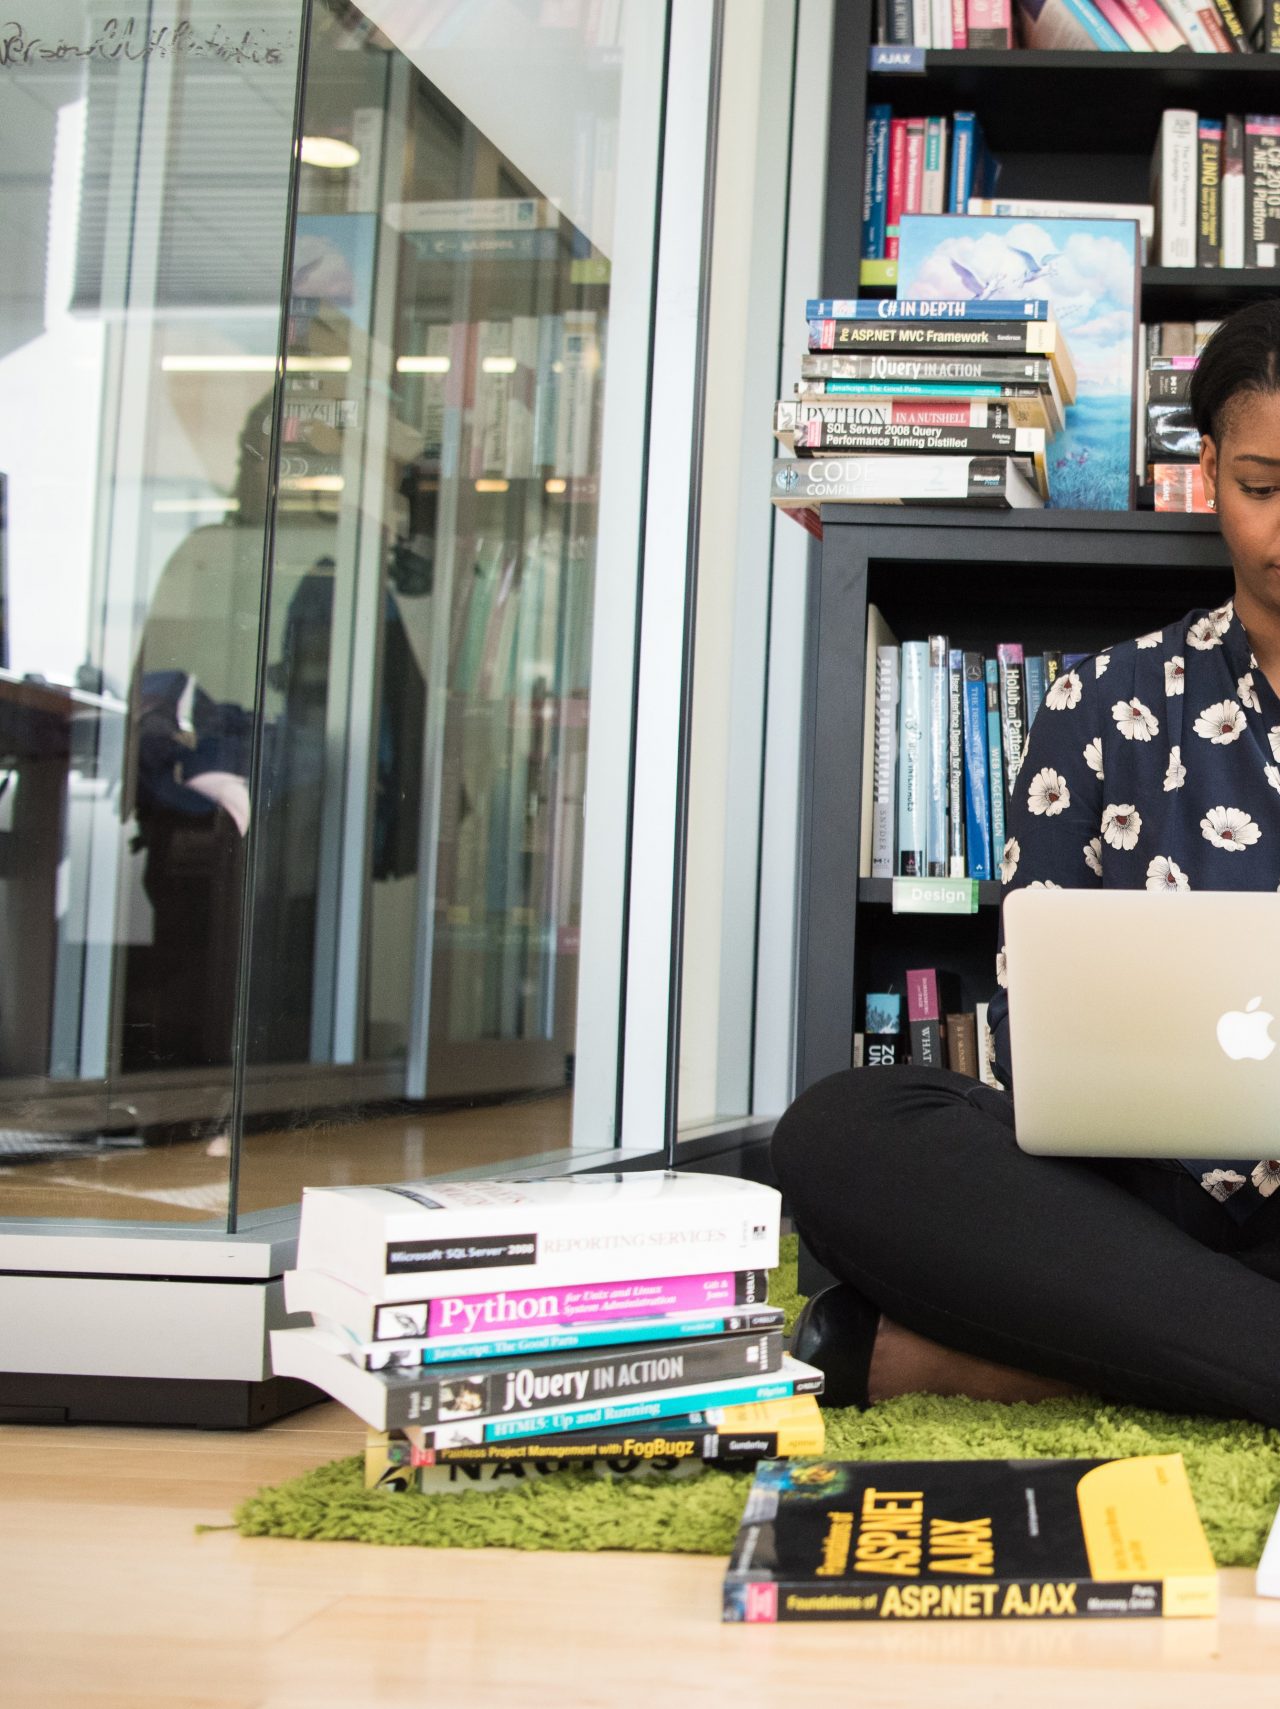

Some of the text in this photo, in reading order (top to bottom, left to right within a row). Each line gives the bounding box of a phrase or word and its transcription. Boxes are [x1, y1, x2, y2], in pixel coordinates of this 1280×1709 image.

[879, 53, 911, 64] AJAX
[1201, 153, 1217, 185] LINQ
[864, 149, 876, 221] Communications
[1252, 147, 1267, 241] .NET 4 Platform
[878, 300, 966, 318] C# IN DEPTH
[840, 327, 848, 342] Pro
[851, 329, 896, 342] ASP.NET
[899, 330, 924, 342] MVC
[926, 331, 989, 343] Framework
[869, 358, 981, 378] jQuery IN ACTION
[883, 385, 901, 393] Good
[806, 407, 967, 425] PYTHON IN A NUTSHELL
[826, 424, 942, 438] SQL Server 2008 Query
[826, 436, 967, 448] Performance Tuning Distilled
[879, 658, 891, 701] PAPER
[951, 690, 961, 729] Interface
[1007, 669, 1023, 772] Holub on Patterns
[952, 730, 961, 752] Design
[952, 753, 962, 762] for
[992, 768, 1000, 797] PAGE
[993, 800, 1003, 837] DESIGN
[911, 888, 965, 904] Design
[922, 1026, 932, 1063] WHAT
[446, 1247, 465, 1260] SQL
[468, 1245, 502, 1259] Server
[508, 1243, 535, 1254] 2008
[544, 1233, 643, 1255] REPORTING
[646, 1228, 727, 1246] SERVICES
[440, 1295, 560, 1328] Python
[583, 1291, 609, 1302] Unix
[610, 1287, 631, 1299] and
[632, 1284, 663, 1297] Linux
[563, 1303, 599, 1317] System
[493, 1342, 515, 1354] The
[518, 1339, 548, 1352] Good
[550, 1335, 579, 1348] Parts
[502, 1356, 685, 1411] jQuery IN ACTION
[494, 1401, 661, 1436] HTML5: Up and Running
[441, 1438, 695, 1459] Painless Project Management with FogBugz
[854, 1487, 924, 1577] ASP.NET
[928, 1516, 994, 1577] AJAX
[786, 1584, 1077, 1618] Foundations of ASP.NET AJAX
